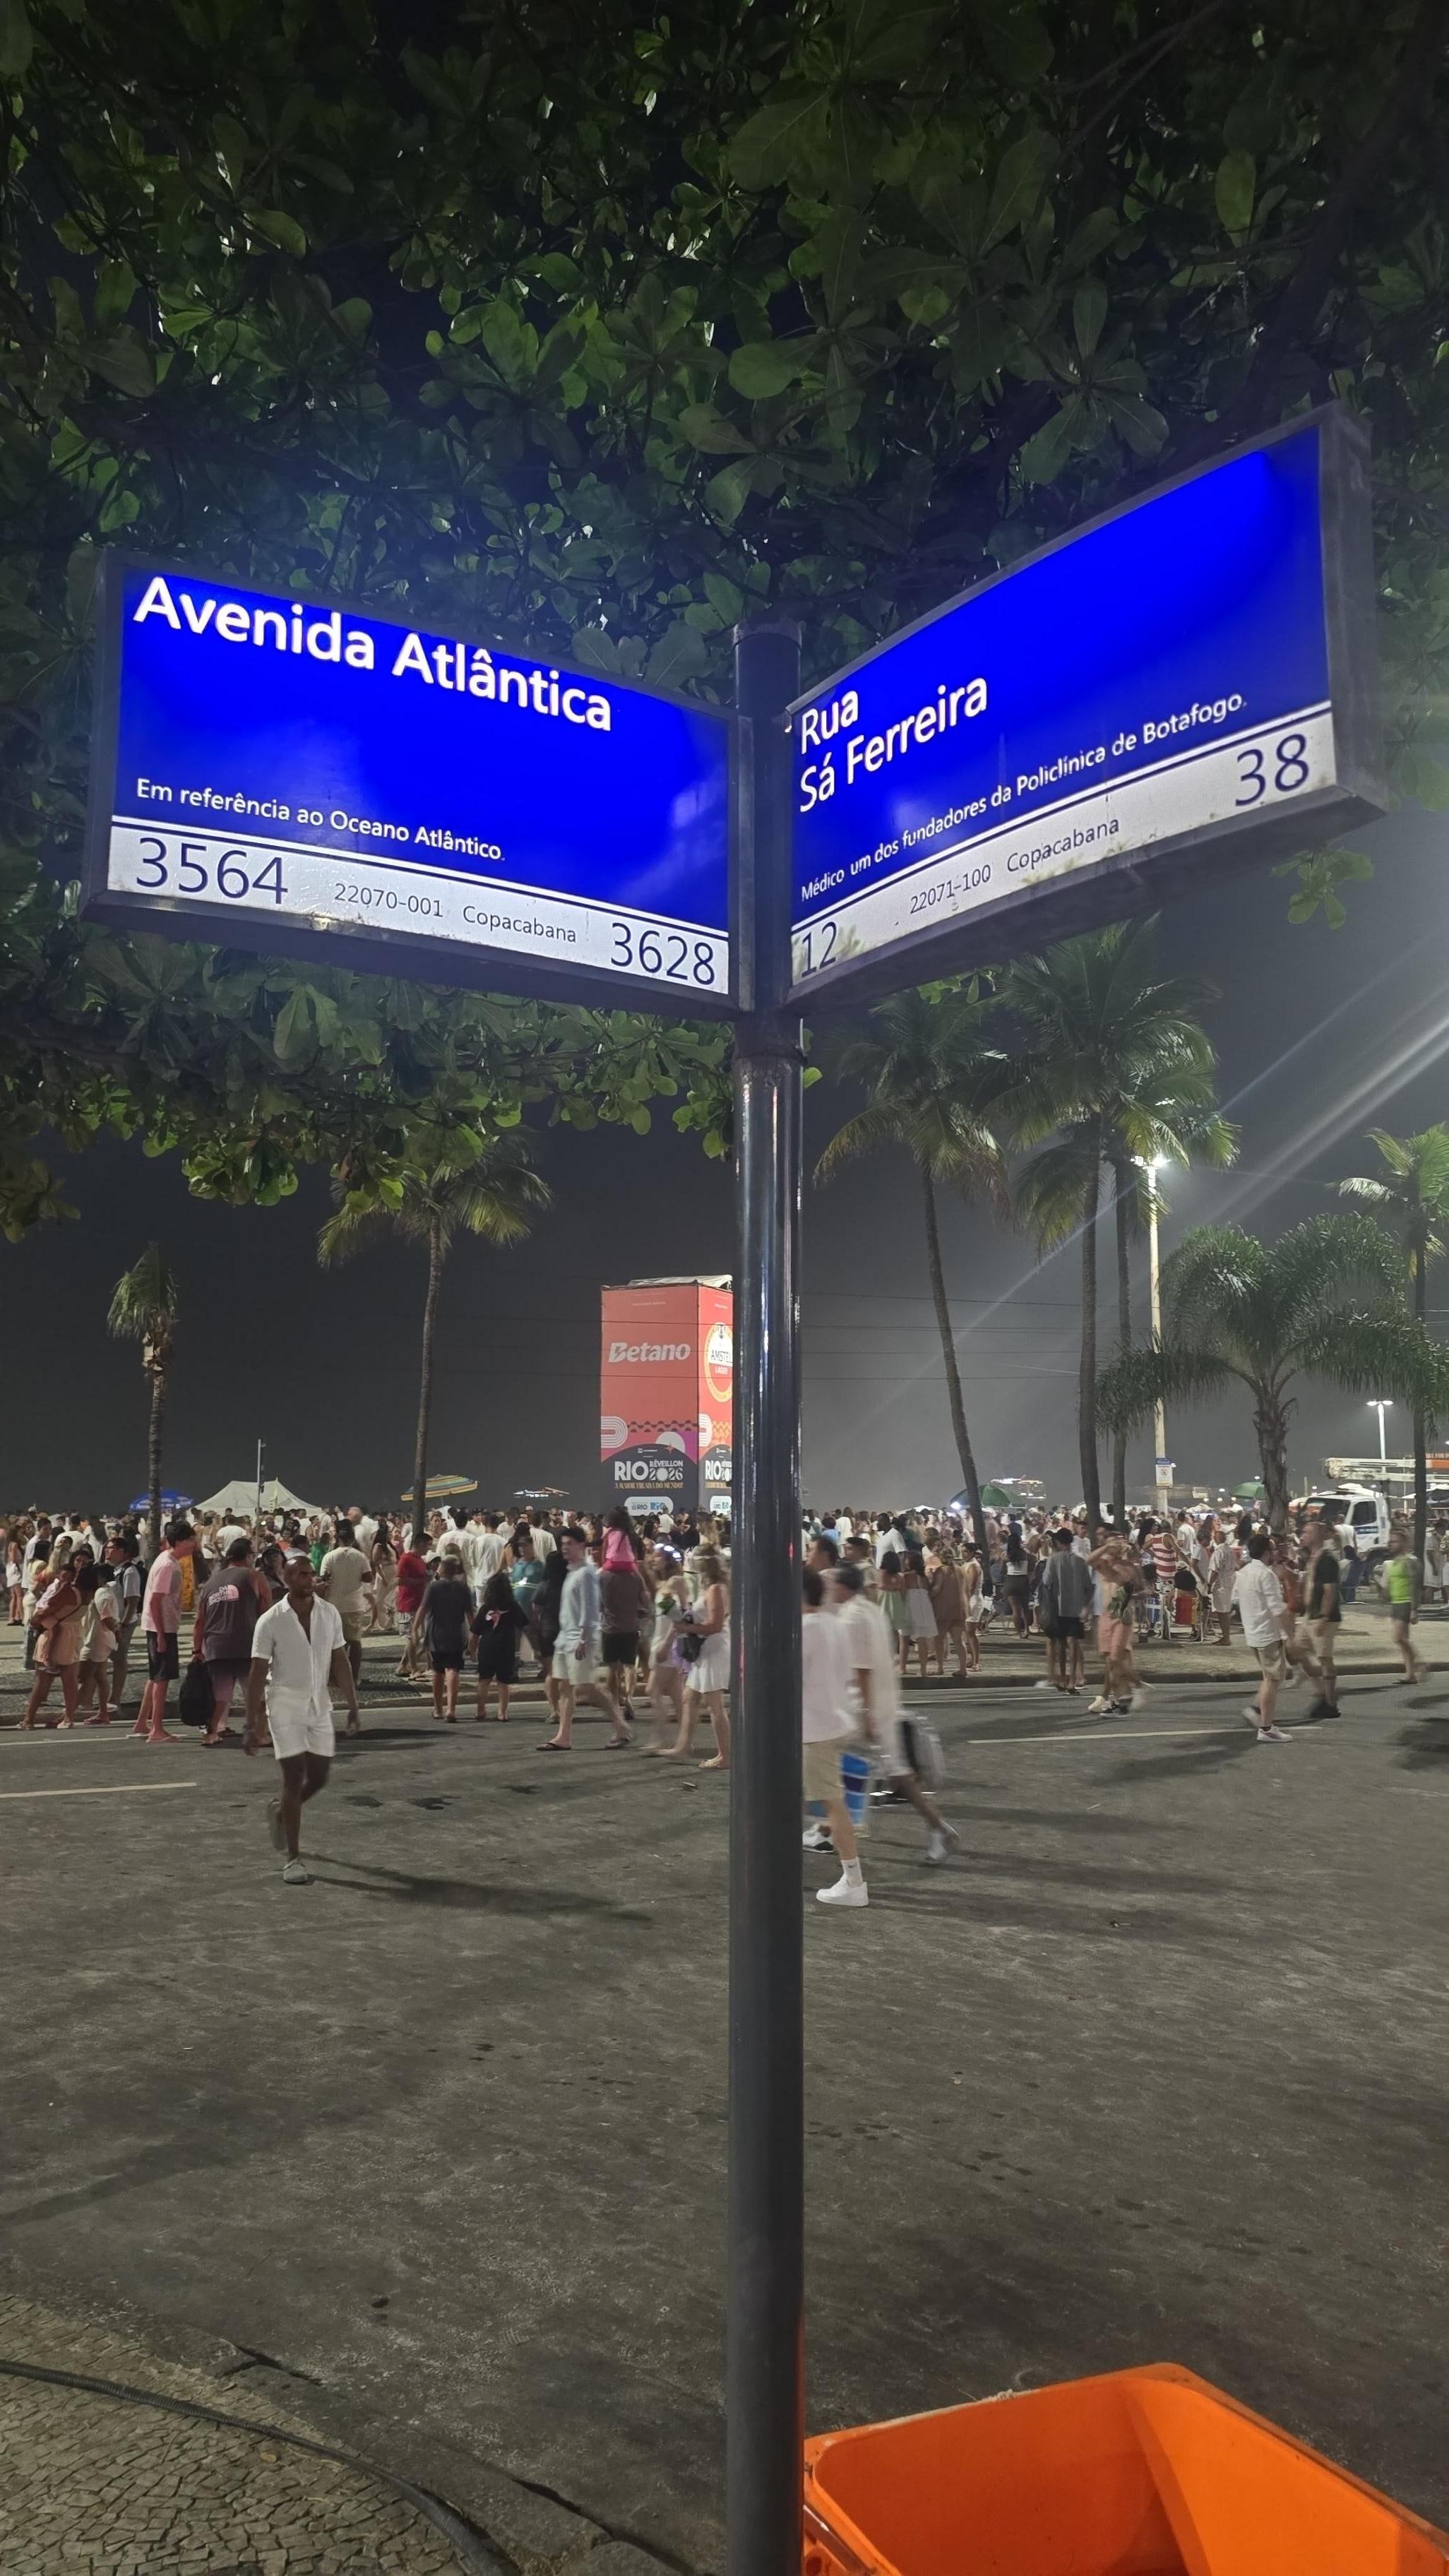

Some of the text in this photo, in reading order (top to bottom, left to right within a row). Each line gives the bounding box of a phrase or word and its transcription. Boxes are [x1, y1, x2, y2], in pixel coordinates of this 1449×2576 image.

[133, 576, 612, 732] Avenida Atlântica
[799, 677, 988, 813] Sá Ferreira
[801, 689, 859, 755] Rua
[1234, 733, 1310, 808] 38
[136, 777, 172, 801] Em
[180, 787, 290, 821] referência
[297, 808, 324, 826] ao
[330, 809, 410, 842] Oceano
[801, 869, 845, 902] Médico
[850, 854, 871, 876] um
[874, 840, 899, 864] dos
[902, 797, 987, 849] fundadores
[991, 785, 1012, 807] da
[1017, 747, 1106, 796] Policlínica
[1111, 732, 1138, 756] de
[135, 836, 289, 905] 3564
[910, 818, 1121, 914] 22071-100 Copacabana
[333, 882, 577, 943] 22070-001 Copacabana
[609, 921, 716, 986] 3628
[801, 920, 838, 979] 12
[608, 1342, 691, 1362] Betano
[614, 1461, 649, 1481] RIO
[649, 1459, 684, 1467] RÉVEILLON
[649, 1467, 684, 1481] 2026
[705, 1460, 722, 1480] RIO
